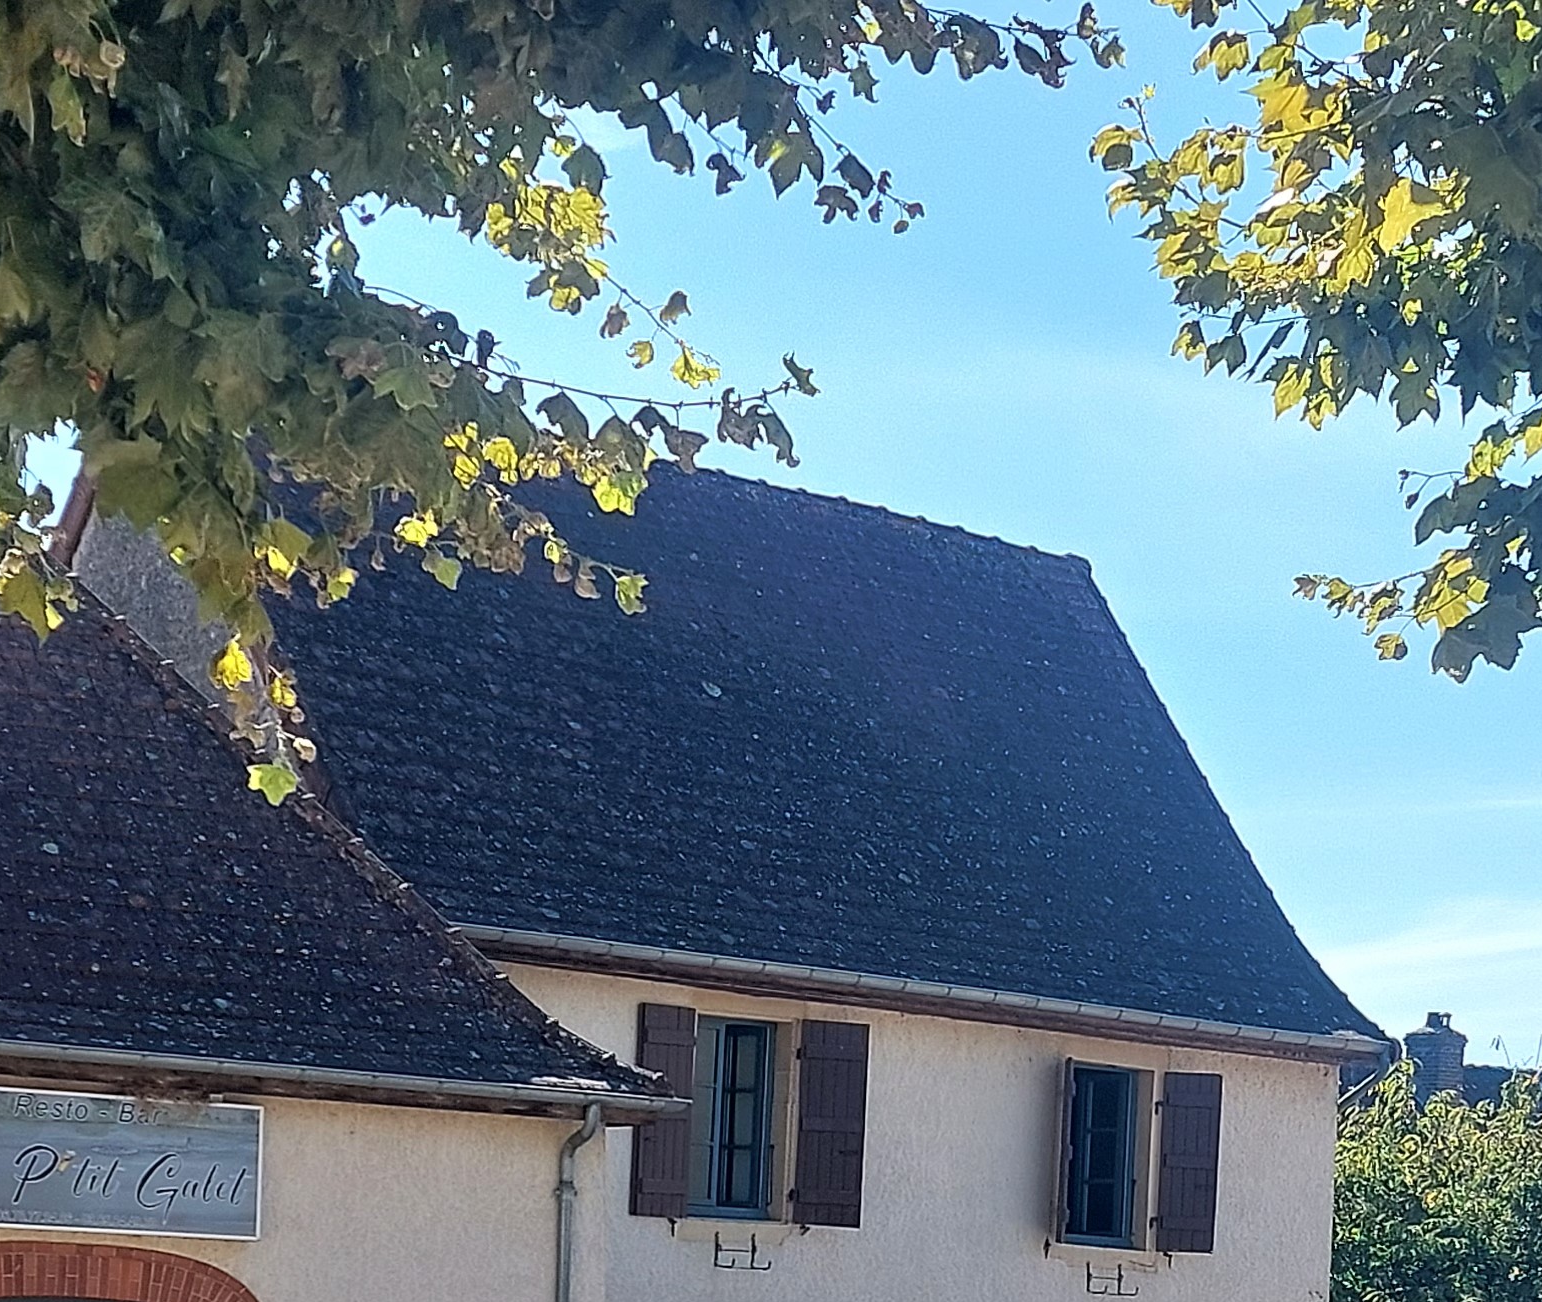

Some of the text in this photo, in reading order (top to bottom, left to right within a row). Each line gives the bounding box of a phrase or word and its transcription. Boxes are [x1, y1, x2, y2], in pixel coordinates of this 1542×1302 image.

[14, 1093, 89, 1122] Resto
[118, 1101, 163, 1126] Bar
[135, 1152, 253, 1226] Galet
